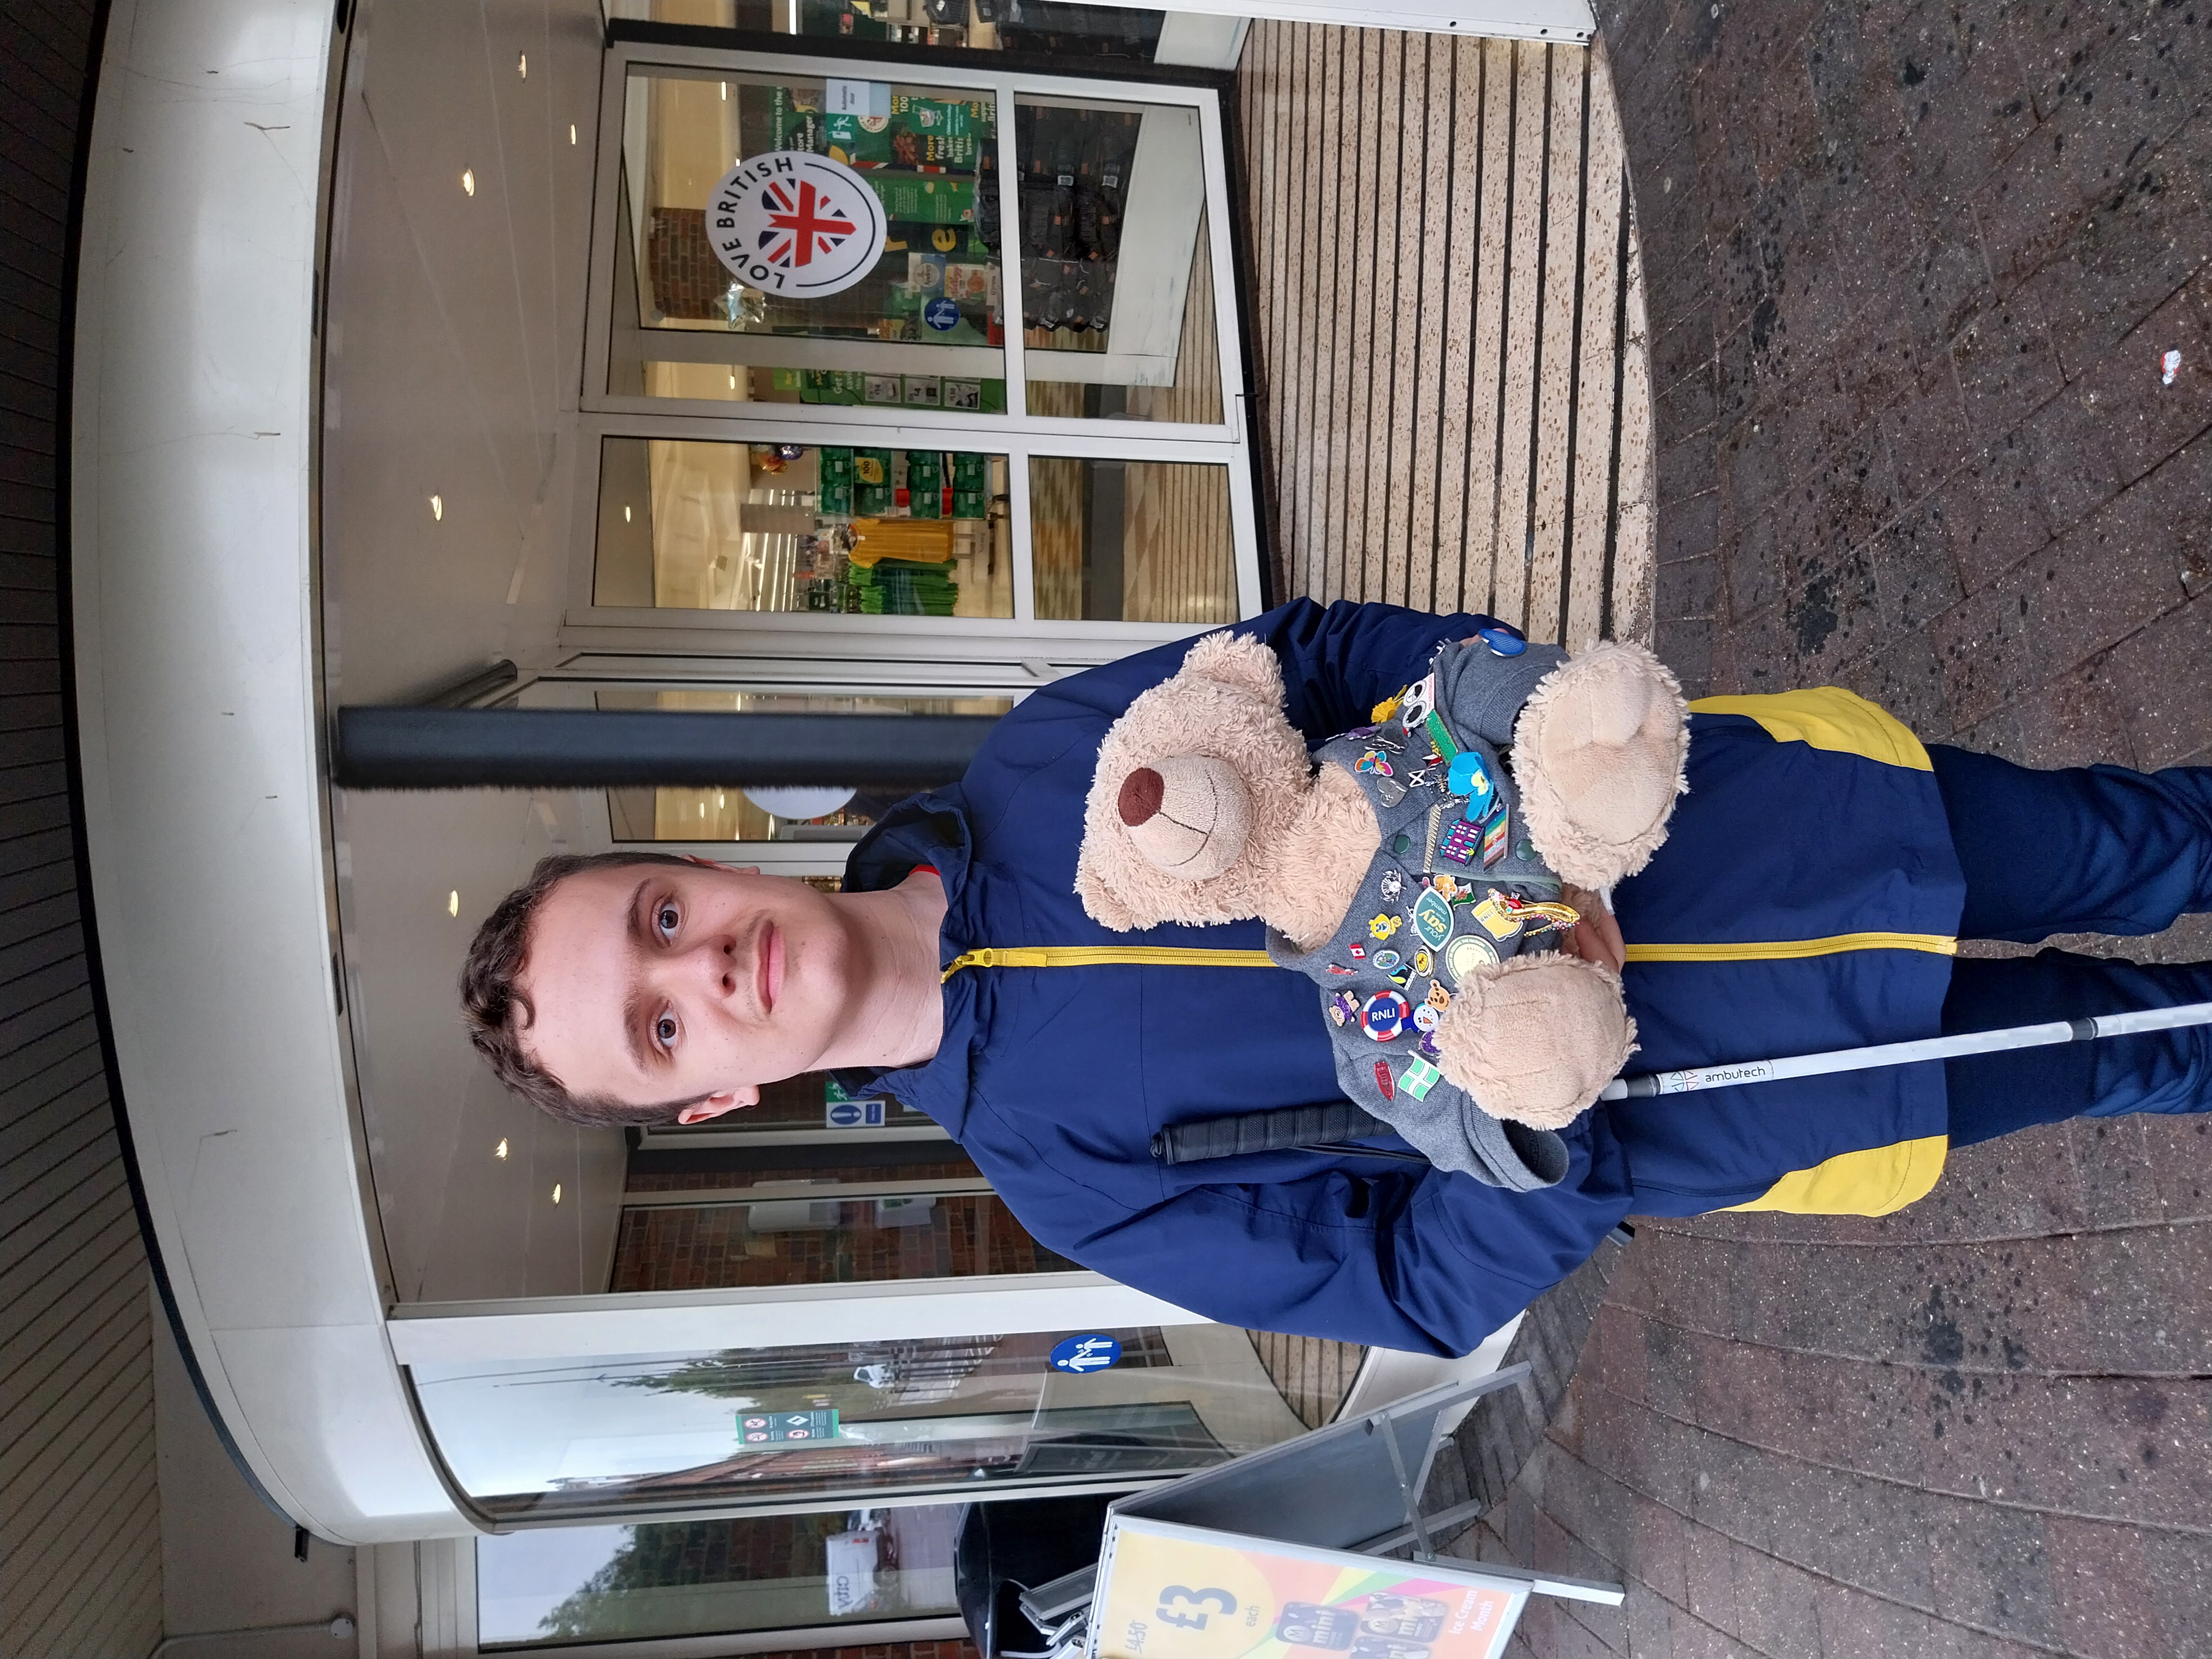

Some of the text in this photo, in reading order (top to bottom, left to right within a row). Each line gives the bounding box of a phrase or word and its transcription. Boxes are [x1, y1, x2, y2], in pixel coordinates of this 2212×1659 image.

[774, 90, 783, 106] the
[900, 97, 909, 113] 100
[775, 106, 783, 115] to
[970, 102, 979, 118] Mo
[987, 102, 995, 121] Briti
[796, 132, 805, 151] tore
[805, 115, 815, 152] Manager
[927, 135, 935, 161] More
[954, 137, 964, 164] Britis
[716, 157, 793, 289] LOVE BRITISH
[833, 377, 843, 394] Get
[844, 372, 853, 390] savi
[914, 388, 922, 397] £4
[1425, 896, 1448, 915] member
[1417, 909, 1447, 933] say
[1436, 912, 1446, 922] forum
[1480, 910, 1494, 922] RNLI
[1424, 925, 1445, 941] your
[1488, 951, 1497, 964] VID-19
[1371, 1007, 1396, 1022] RNLI
[1705, 1066, 1766, 1082] ambutech
[1155, 1585, 1238, 1630] £3
[1244, 1605, 1261, 1627] each
[1448, 1590, 1478, 1635] Ice Cream
[1470, 1600, 1494, 1631] Month
[1124, 1621, 1148, 1651] £4.50
[1311, 1610, 1336, 1644] mini
